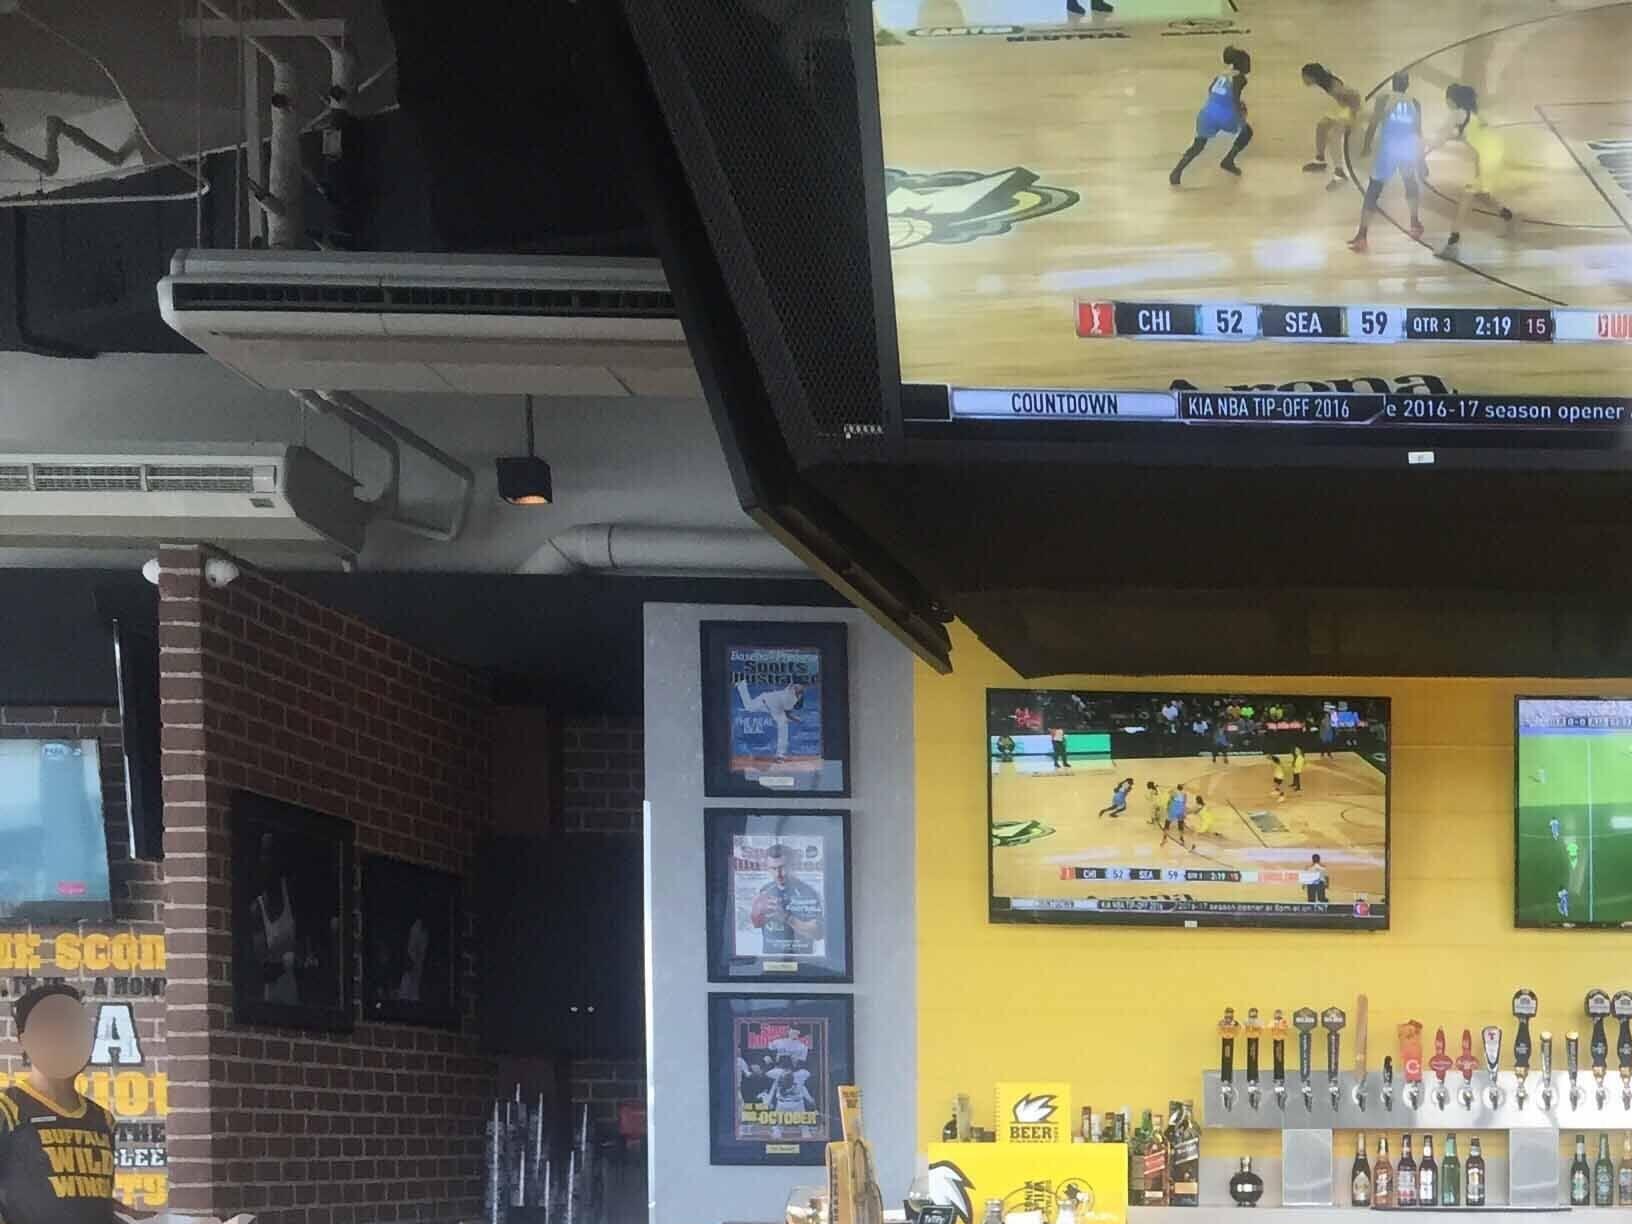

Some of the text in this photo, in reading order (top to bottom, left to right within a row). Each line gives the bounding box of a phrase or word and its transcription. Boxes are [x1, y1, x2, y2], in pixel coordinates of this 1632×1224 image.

[1138, 310, 1171, 332] CHI
[1215, 310, 1244, 333] 52
[1284, 312, 1323, 333] SEA
[1360, 311, 1389, 334] 59
[1413, 317, 1440, 333] QTR
[1442, 317, 1452, 333] 3
[1475, 315, 1512, 335] 2:19
[1525, 318, 1547, 334] 15
[1011, 392, 1119, 415] COUNTDOWN
[1188, 397, 1350, 418] KIA NBA TIP-OFF 2016
[1403, 400, 1478, 418] 2016-17
[1484, 404, 1551, 419] season
[1557, 405, 1626, 423] opener
[1167, 870, 1179, 880] 59
[1010, 1126, 1052, 1139] BEER
